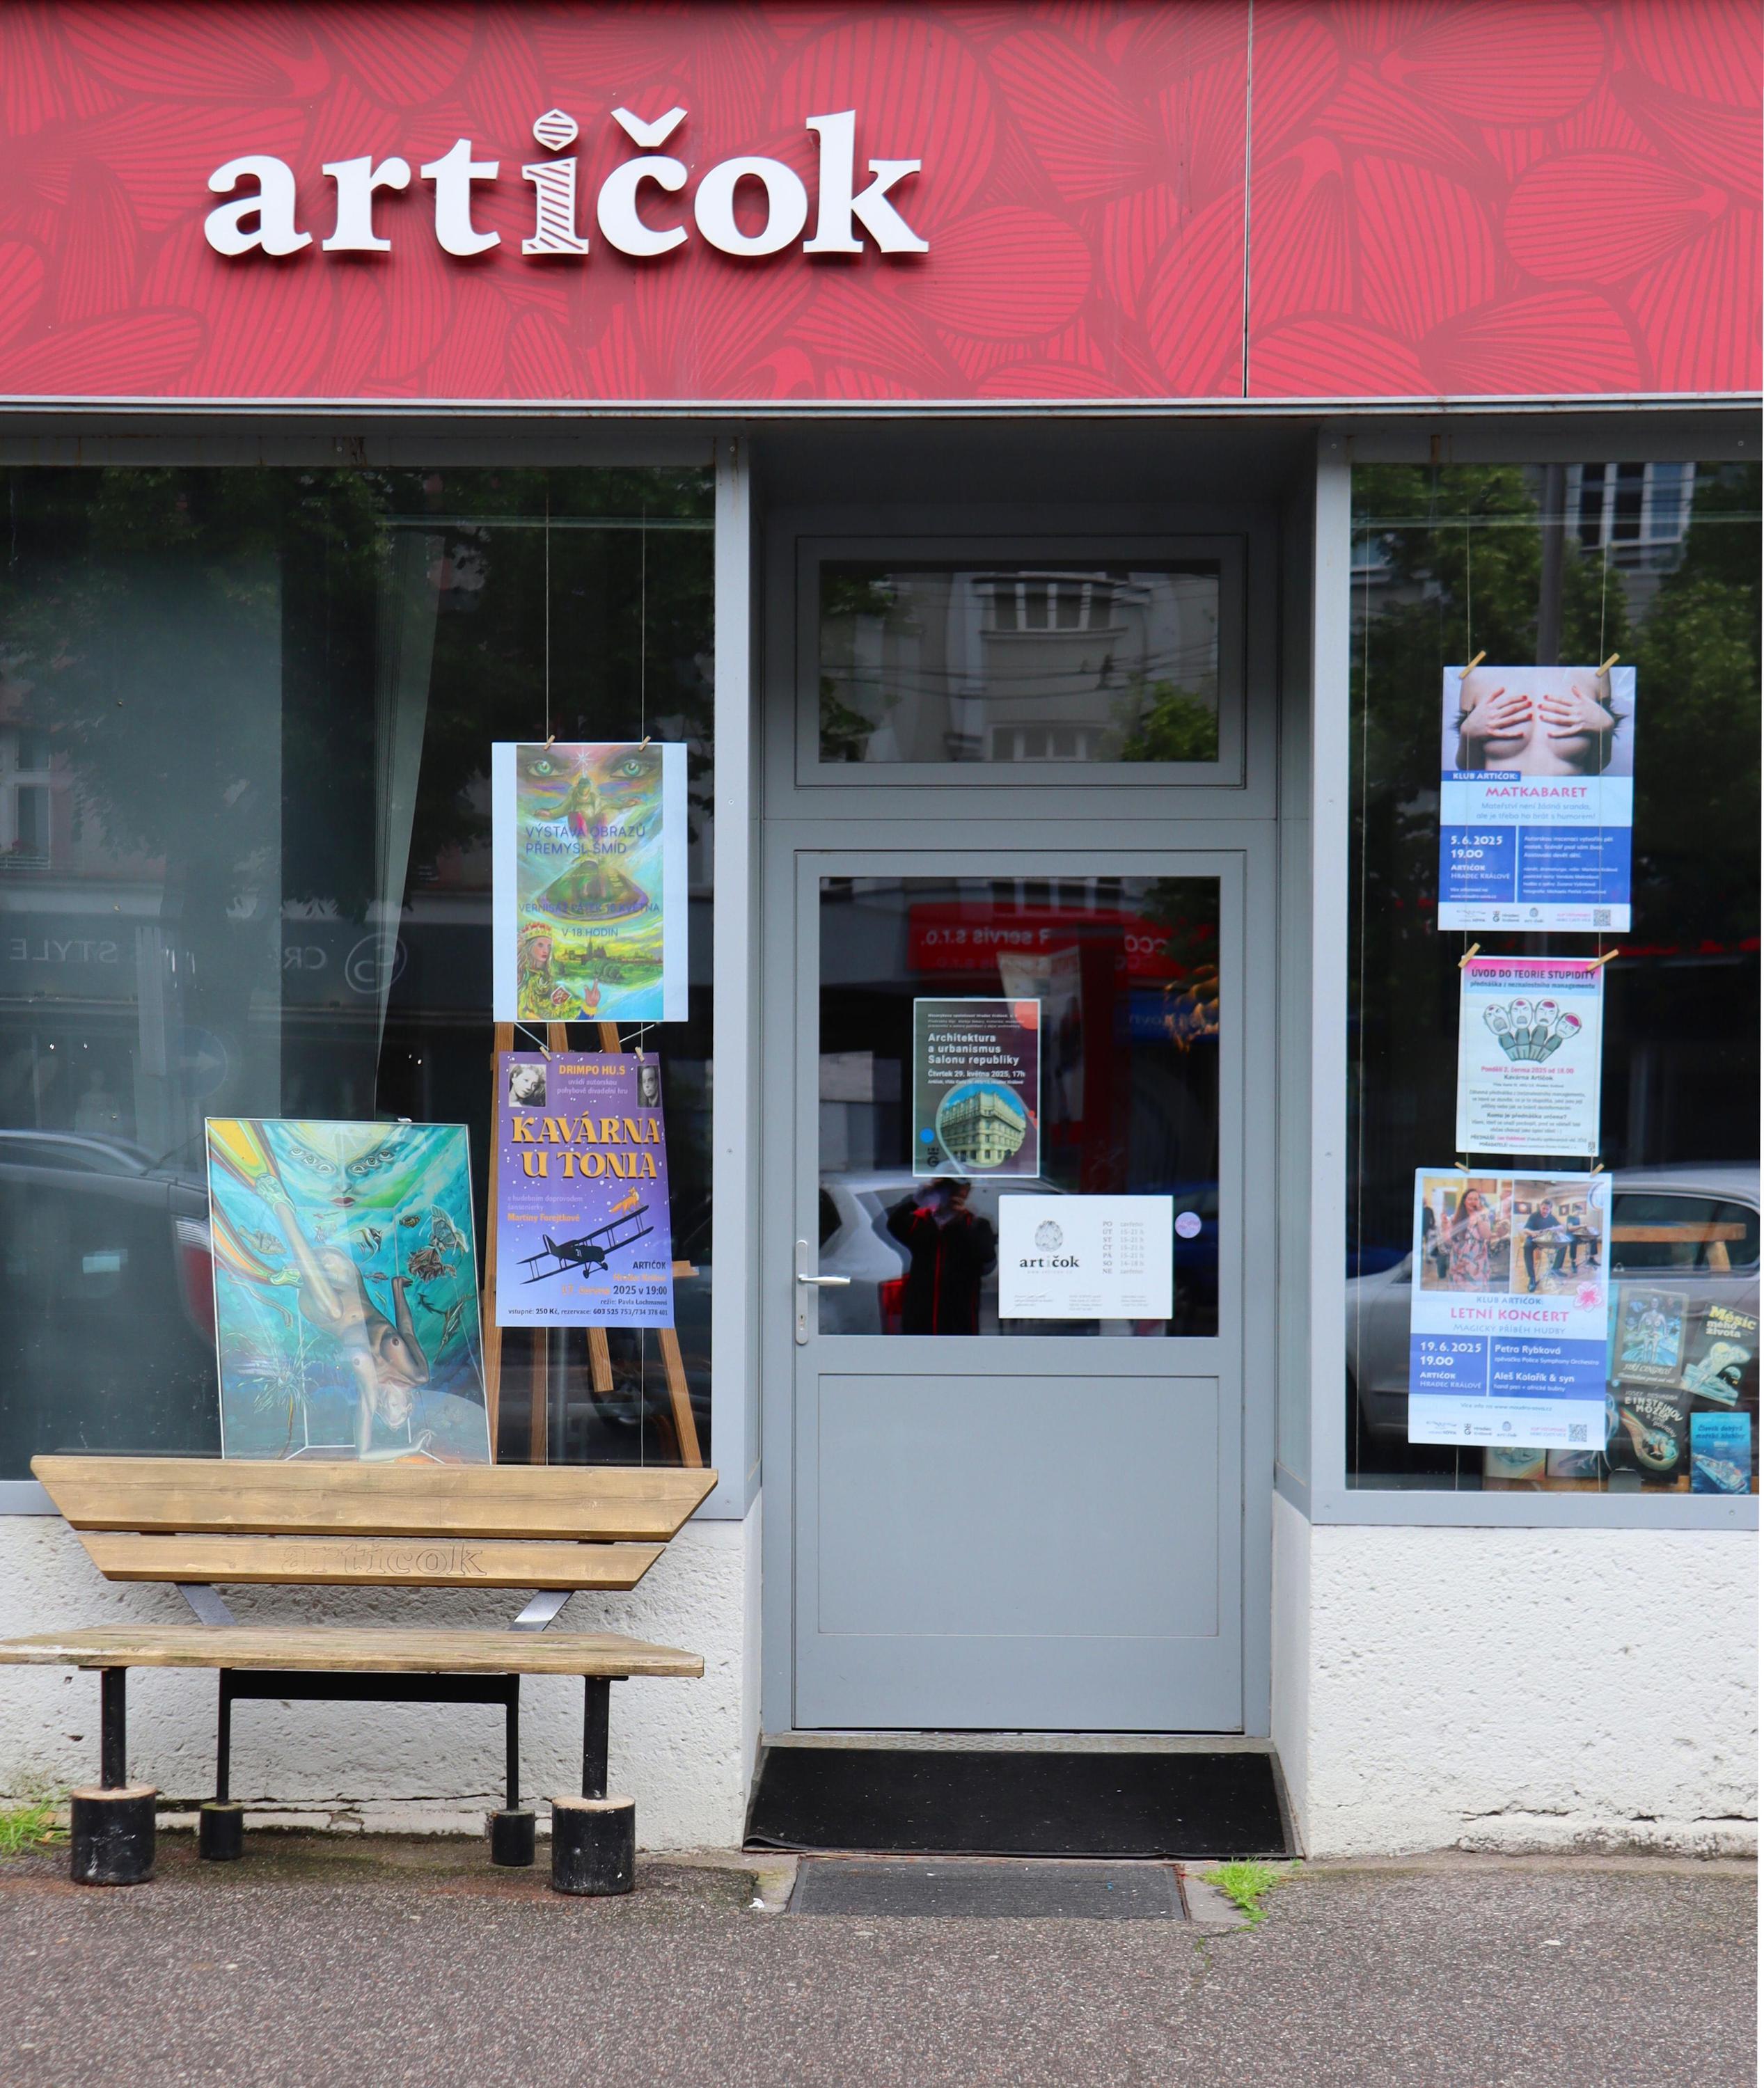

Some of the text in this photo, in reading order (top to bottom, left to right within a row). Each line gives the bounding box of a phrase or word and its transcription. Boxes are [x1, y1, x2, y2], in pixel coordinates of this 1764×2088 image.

[204, 107, 929, 256] artičok
[1486, 787, 1587, 798] MATKABARET
[526, 823, 586, 838] VÝSTAVA
[526, 840, 627, 855] PŘEMYSL ŠMÍD
[1451, 849, 1483, 858] 19.00
[562, 928, 569, 937] V
[585, 928, 619, 937] HODIN
[1472, 967, 1596, 979] ÚVOD DO TEORIE STUPIDITY
[928, 1033, 996, 1043] Architektura
[938, 1044, 1001, 1053] urbanismus
[928, 1054, 1020, 1066] Salonu republiky
[559, 1065, 625, 1075] DRIMPO HU.S
[928, 1069, 953, 1077] Čtvrtek
[512, 1111, 660, 1144] KAVÁRNA
[522, 1151, 657, 1179] U TONIA
[633, 1260, 666, 1270] ARTIČOK
[1019, 1255, 1080, 1267] artičok
[613, 1286, 636, 1295] 2025
[646, 1286, 668, 1295] 19:00
[1451, 1306, 1570, 1322] LETNÍ KONCERT
[1709, 1305, 1756, 1330] Měsíc
[1499, 1323, 1530, 1334] PŘÍBĚH
[1534, 1327, 1566, 1335] HUDBY
[1706, 1320, 1737, 1330] mého
[1706, 1327, 1740, 1338] života
[1495, 1345, 1561, 1356] Petra Rybková
[1420, 1356, 1454, 1366] 19.00
[1494, 1372, 1575, 1384] Aleš Kolařík & syn
[1451, 1380, 1481, 1389] KRÁLOVÉ
